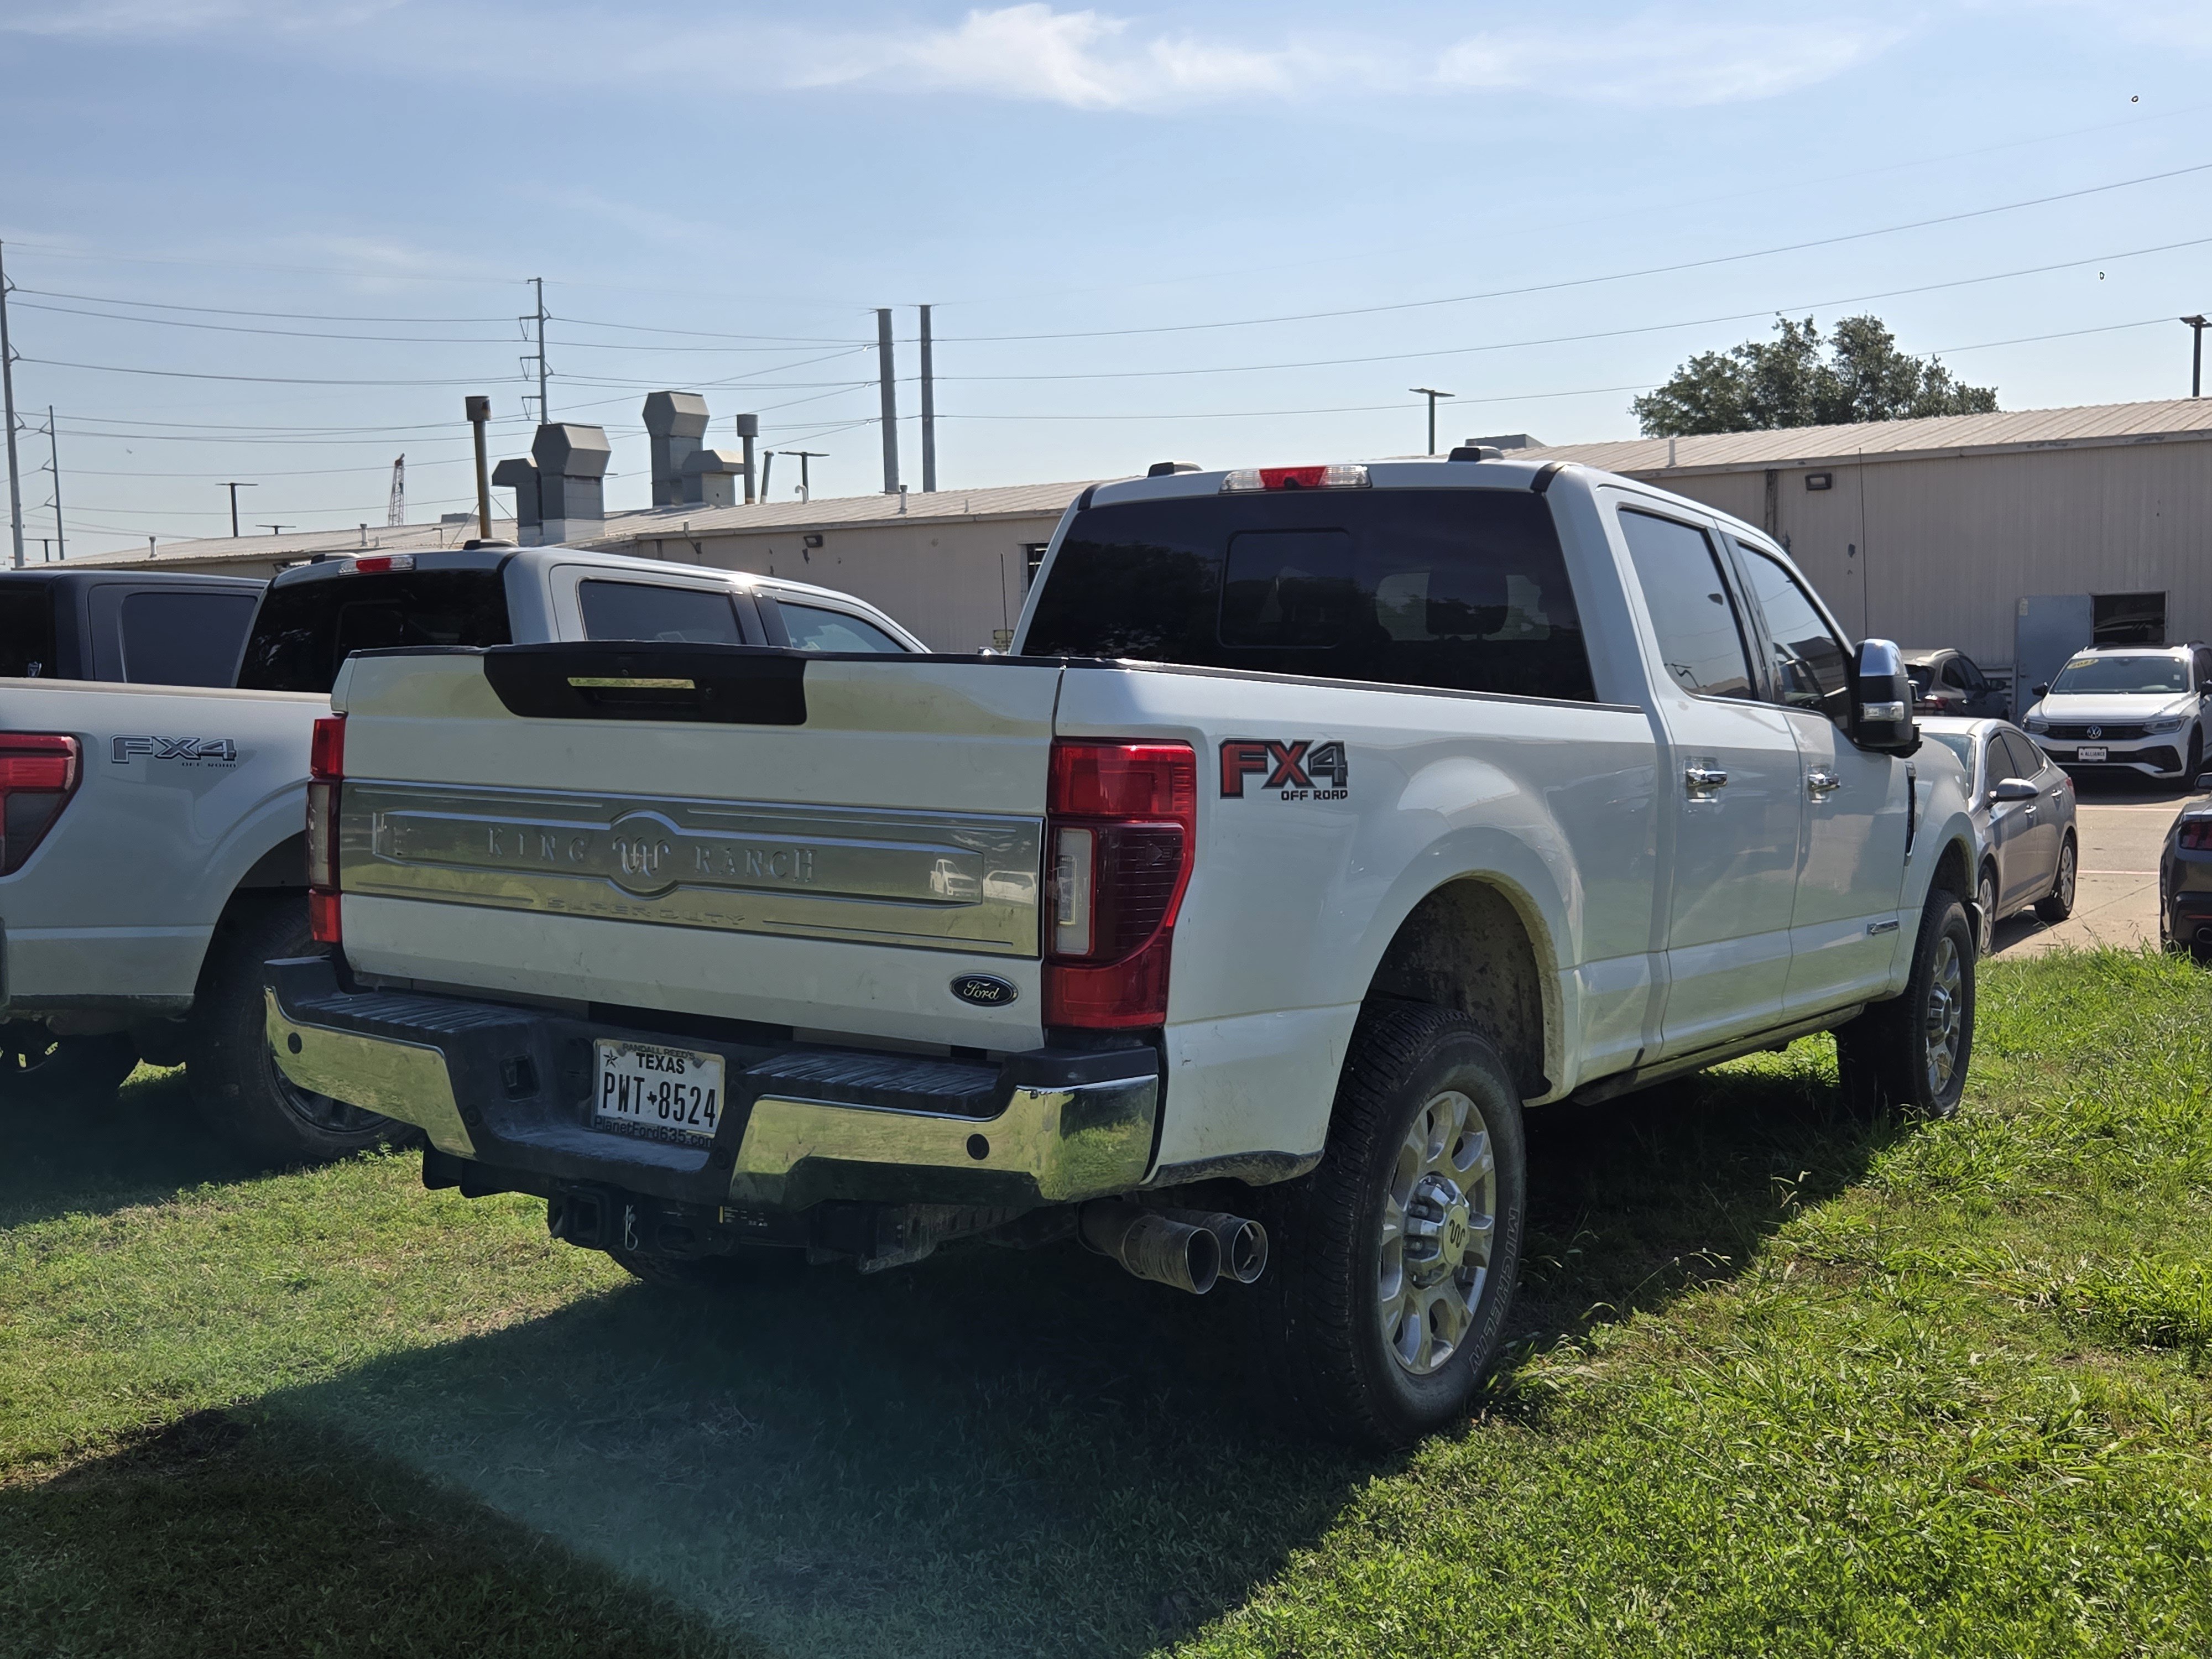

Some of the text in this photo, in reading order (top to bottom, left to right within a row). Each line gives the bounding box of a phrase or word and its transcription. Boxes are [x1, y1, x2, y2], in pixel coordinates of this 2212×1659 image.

[111, 734, 237, 764] FX4
[1218, 738, 1348, 800] FX4
[1281, 790, 1348, 801] OFF ROAD
[487, 827, 818, 883] KING RANCH
[546, 896, 747, 926] SUPER DUTY
[963, 979, 1000, 1000] Ford
[622, 1042, 662, 1055] RANDALL
[635, 1052, 686, 1074] TEXAS
[602, 1071, 716, 1128] PWT 8524
[1468, 1207, 1520, 1375] MICHELIN
